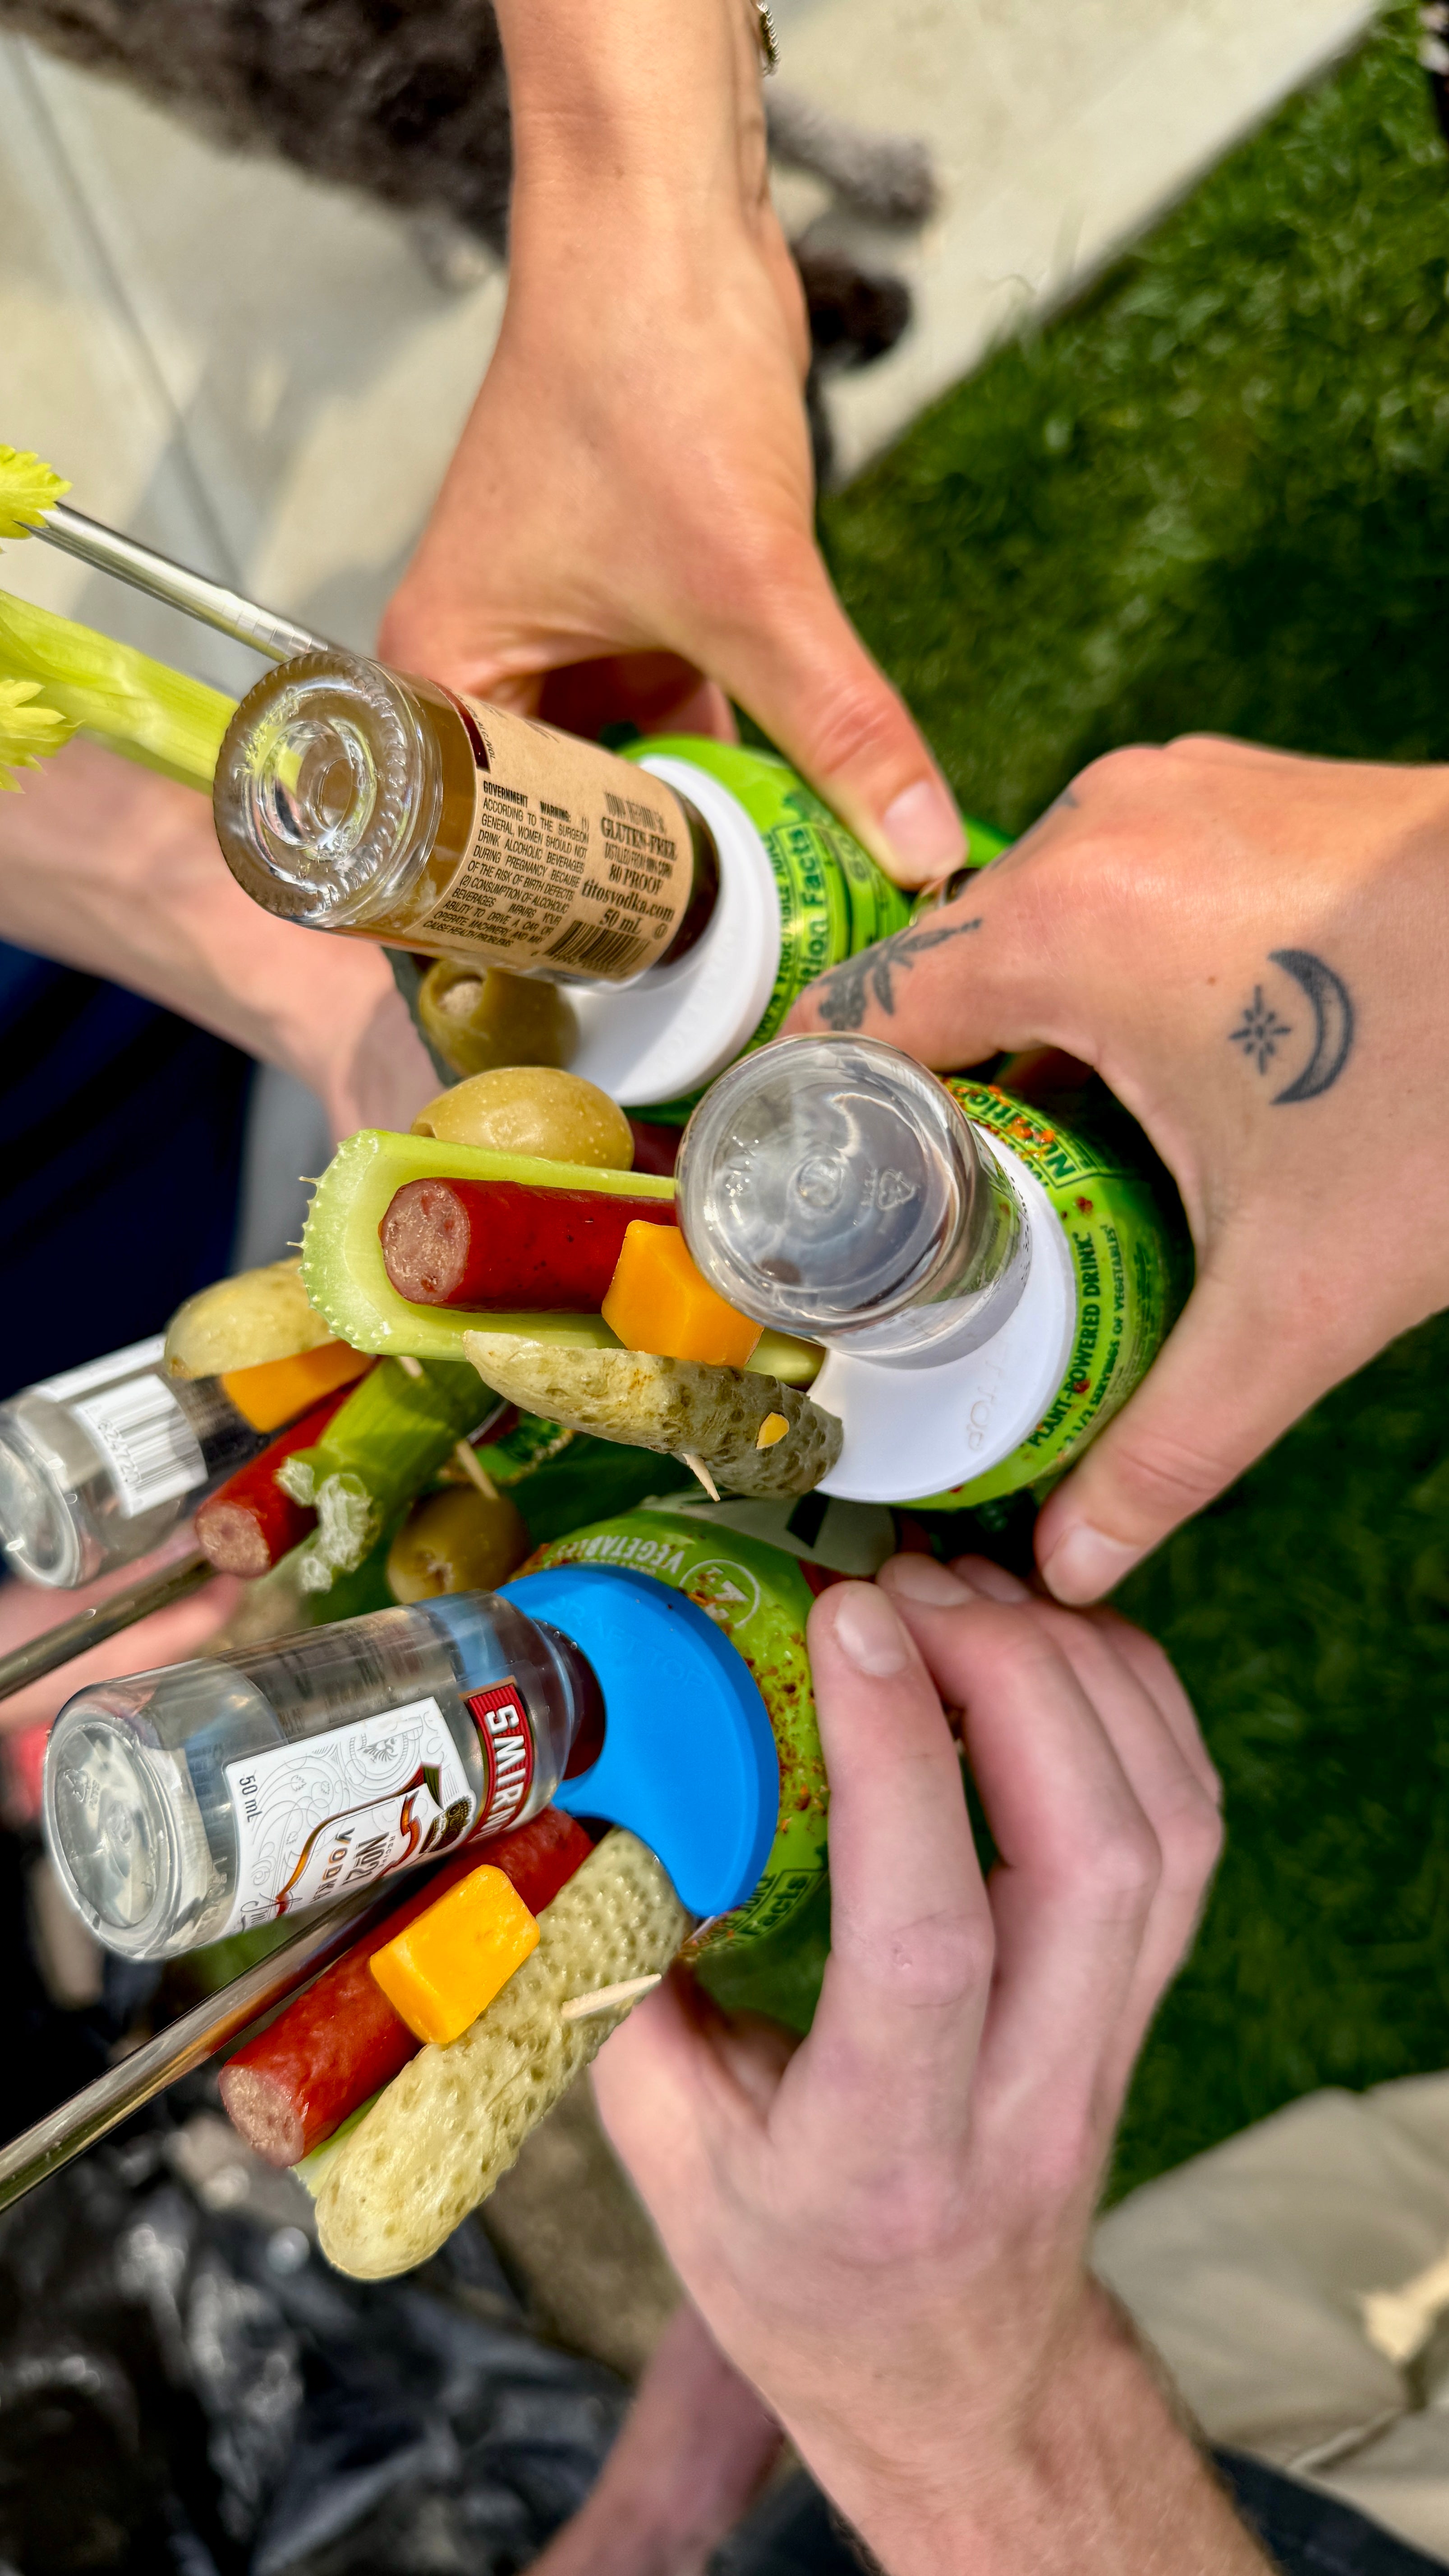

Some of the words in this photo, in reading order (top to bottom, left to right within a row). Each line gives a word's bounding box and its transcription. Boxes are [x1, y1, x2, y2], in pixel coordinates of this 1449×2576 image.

[483, 780, 529, 808] GOVERNMENT
[540, 801, 571, 823] WARNING:
[483, 797, 524, 822] ACCORDING
[528, 813, 537, 826] TO
[540, 817, 553, 832] THE
[558, 823, 589, 845] SURGEON
[478, 829, 501, 847] DRINK
[505, 838, 543, 860] ALCOHOLIC
[546, 851, 585, 874] BEVERAGES
[482, 814, 515, 837] GENERAL,
[518, 826, 543, 845] WOMEN
[546, 835, 572, 854] SHOULD
[575, 845, 588, 860] NOT
[601, 816, 677, 862] GLUTEN-FREE
[468, 860, 480, 872] OF
[479, 863, 495, 876] THE
[496, 868, 512, 882] RISK
[512, 874, 524, 885] OF
[523, 877, 544, 892] BIRTH
[473, 845, 501, 864] DURING
[505, 855, 548, 877] PREGNANCY
[551, 869, 581, 888] BECAUSE
[609, 863, 622, 884] 80
[622, 868, 664, 895] PROOF
[788, 828, 823, 908] Facts
[452, 888, 497, 908] BEVERAGES
[508, 903, 537, 919] IMPAIRS
[543, 912, 562, 926] YOUR
[459, 874, 472, 888] (2)
[471, 877, 523, 901] CONSUMPTION
[521, 891, 533, 902] OF
[531, 896, 570, 914] ALCOHOLIC
[581, 878, 675, 922] titosvodka.com
[423, 920, 451, 934] CAUSE
[446, 925, 476, 940] HEALTH
[433, 911, 469, 925] OPERATE
[511, 931, 529, 942] AND
[443, 901, 472, 914] ABILITY
[474, 907, 486, 918] TO
[487, 912, 511, 925] DRIVE
[522, 921, 540, 933] CAR
[541, 927, 554, 937] OR
[599, 908, 621, 929] 50
[618, 916, 643, 935] mL
[1026, 1303, 1101, 1447] PLANT-POWERED
[1089, 1340, 1120, 1406] SERVINGS
[1113, 1316, 1123, 1335] OF
[239, 1775, 258, 1795] 50
[244, 1799, 263, 1823] mL
[308, 1827, 355, 1904] VODKA
[377, 1835, 396, 1868] RECIPE
[738, 1875, 810, 1936] Facts
